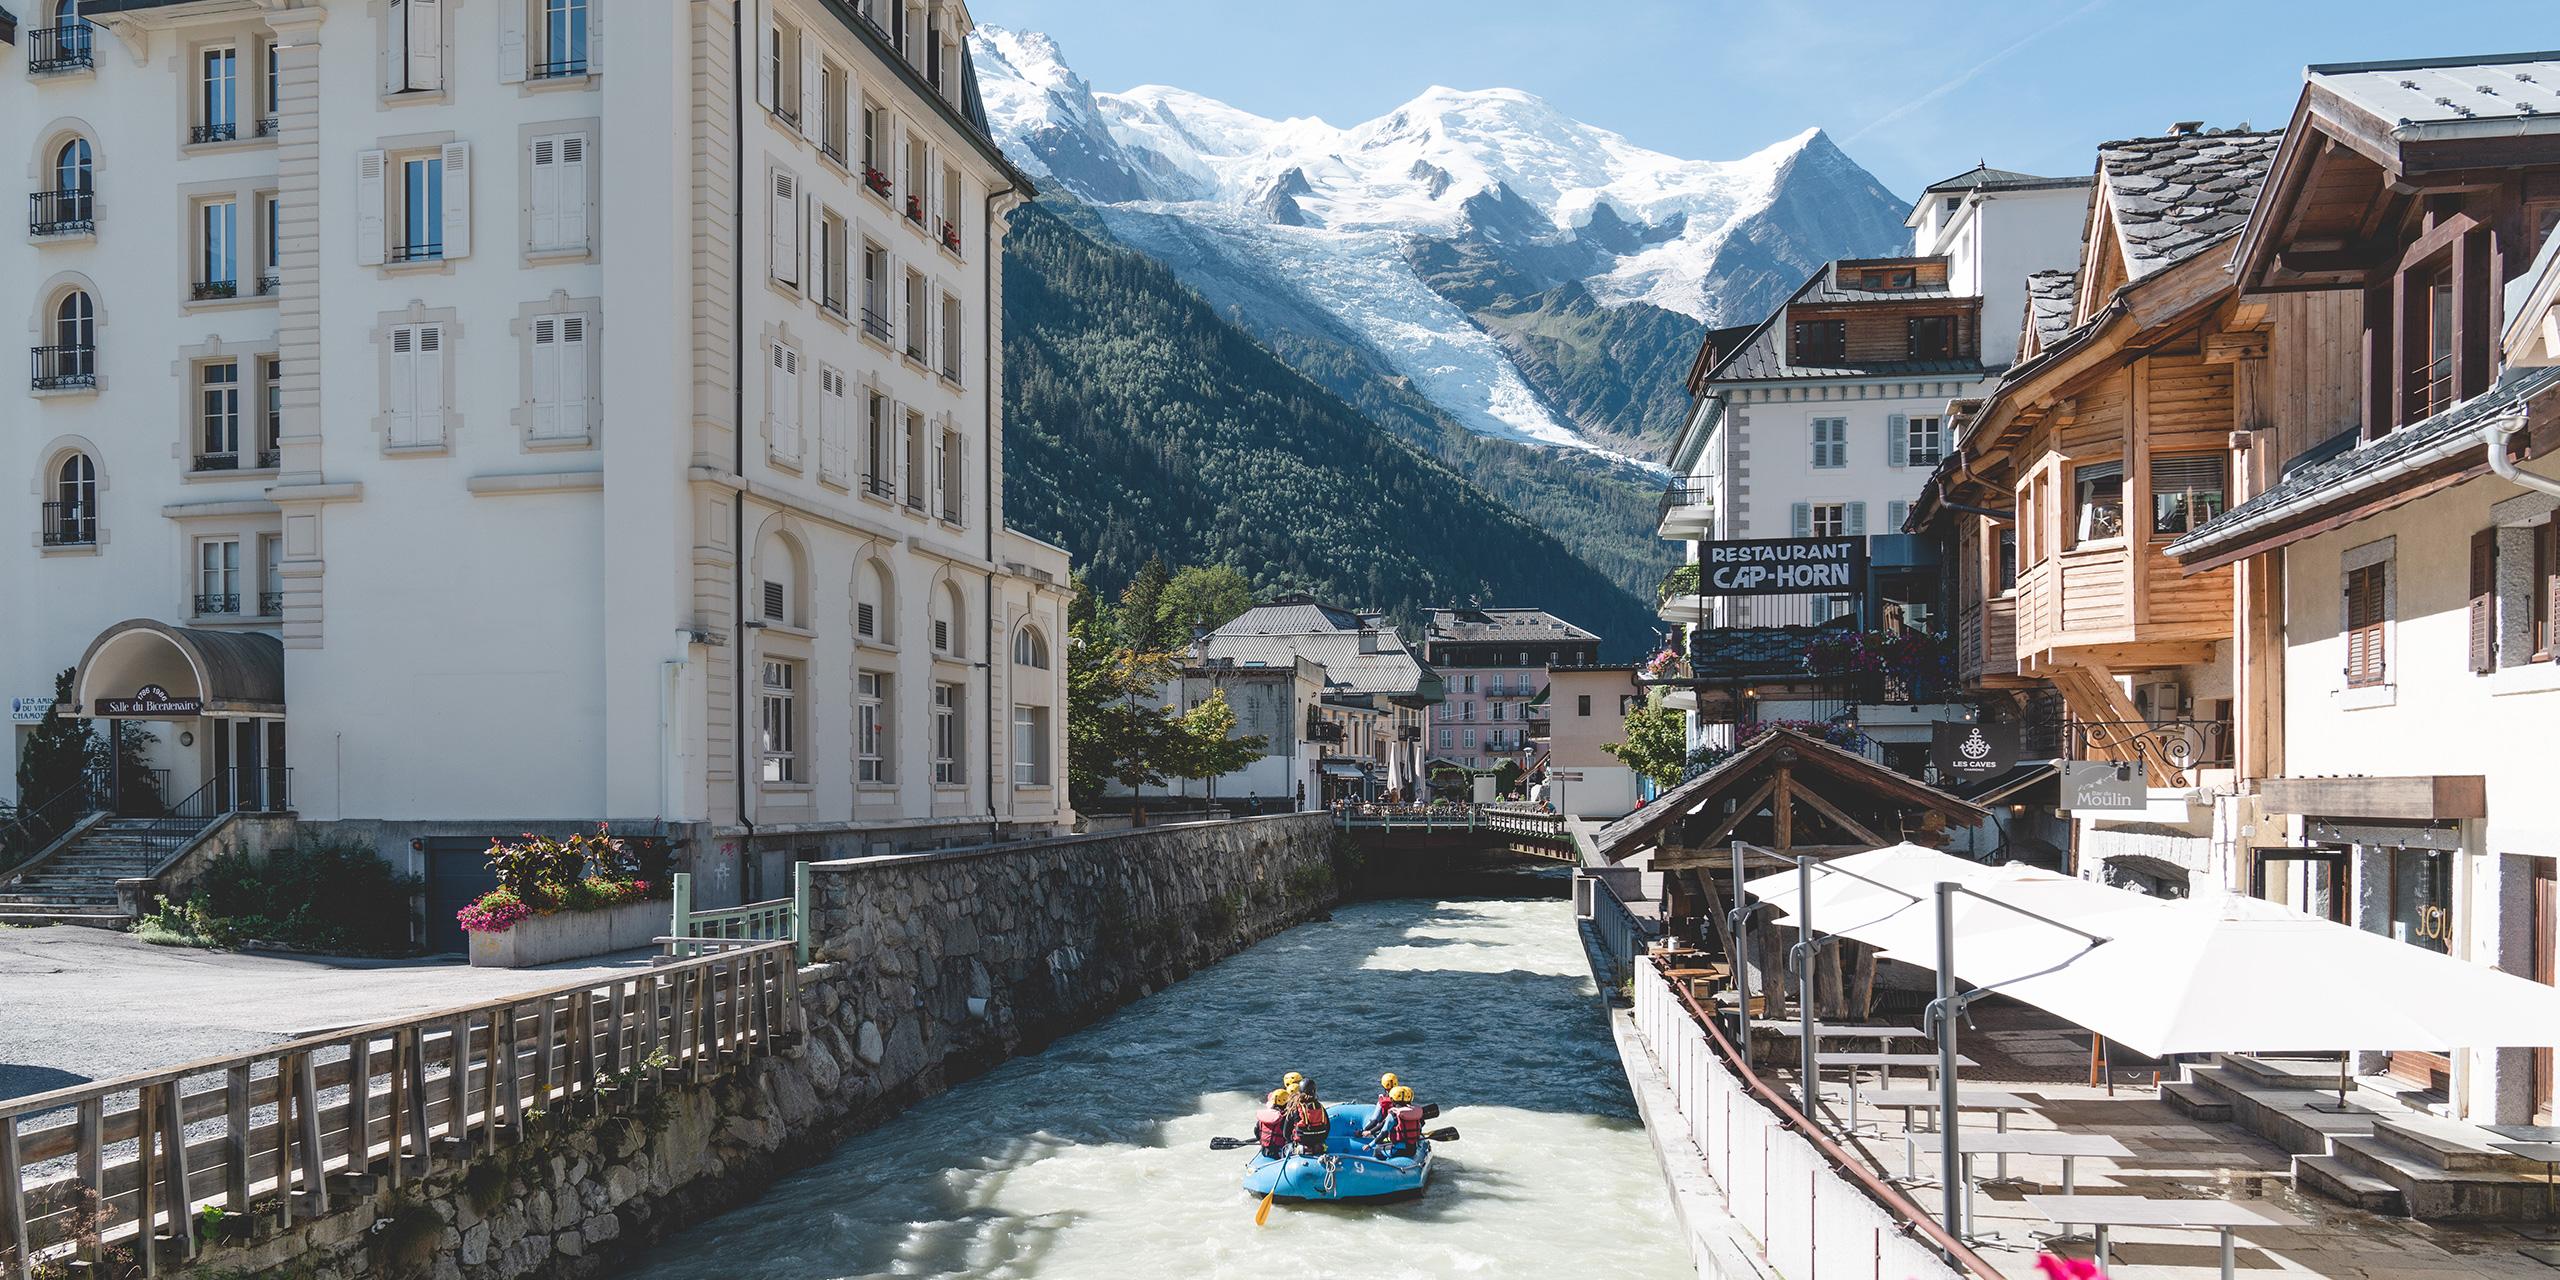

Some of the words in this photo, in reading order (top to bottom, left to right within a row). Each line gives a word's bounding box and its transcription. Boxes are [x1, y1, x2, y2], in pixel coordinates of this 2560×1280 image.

[1712, 543, 1852, 563] RESTAURANT
[1713, 563, 1849, 589] CAP-HORN
[138, 687, 151, 701] 1786
[153, 687, 168, 702] 1986
[109, 701, 129, 712] Salle
[132, 701, 143, 712] du
[146, 701, 199, 711] Bicentenaire
[2076, 792, 2132, 806] Moulin
